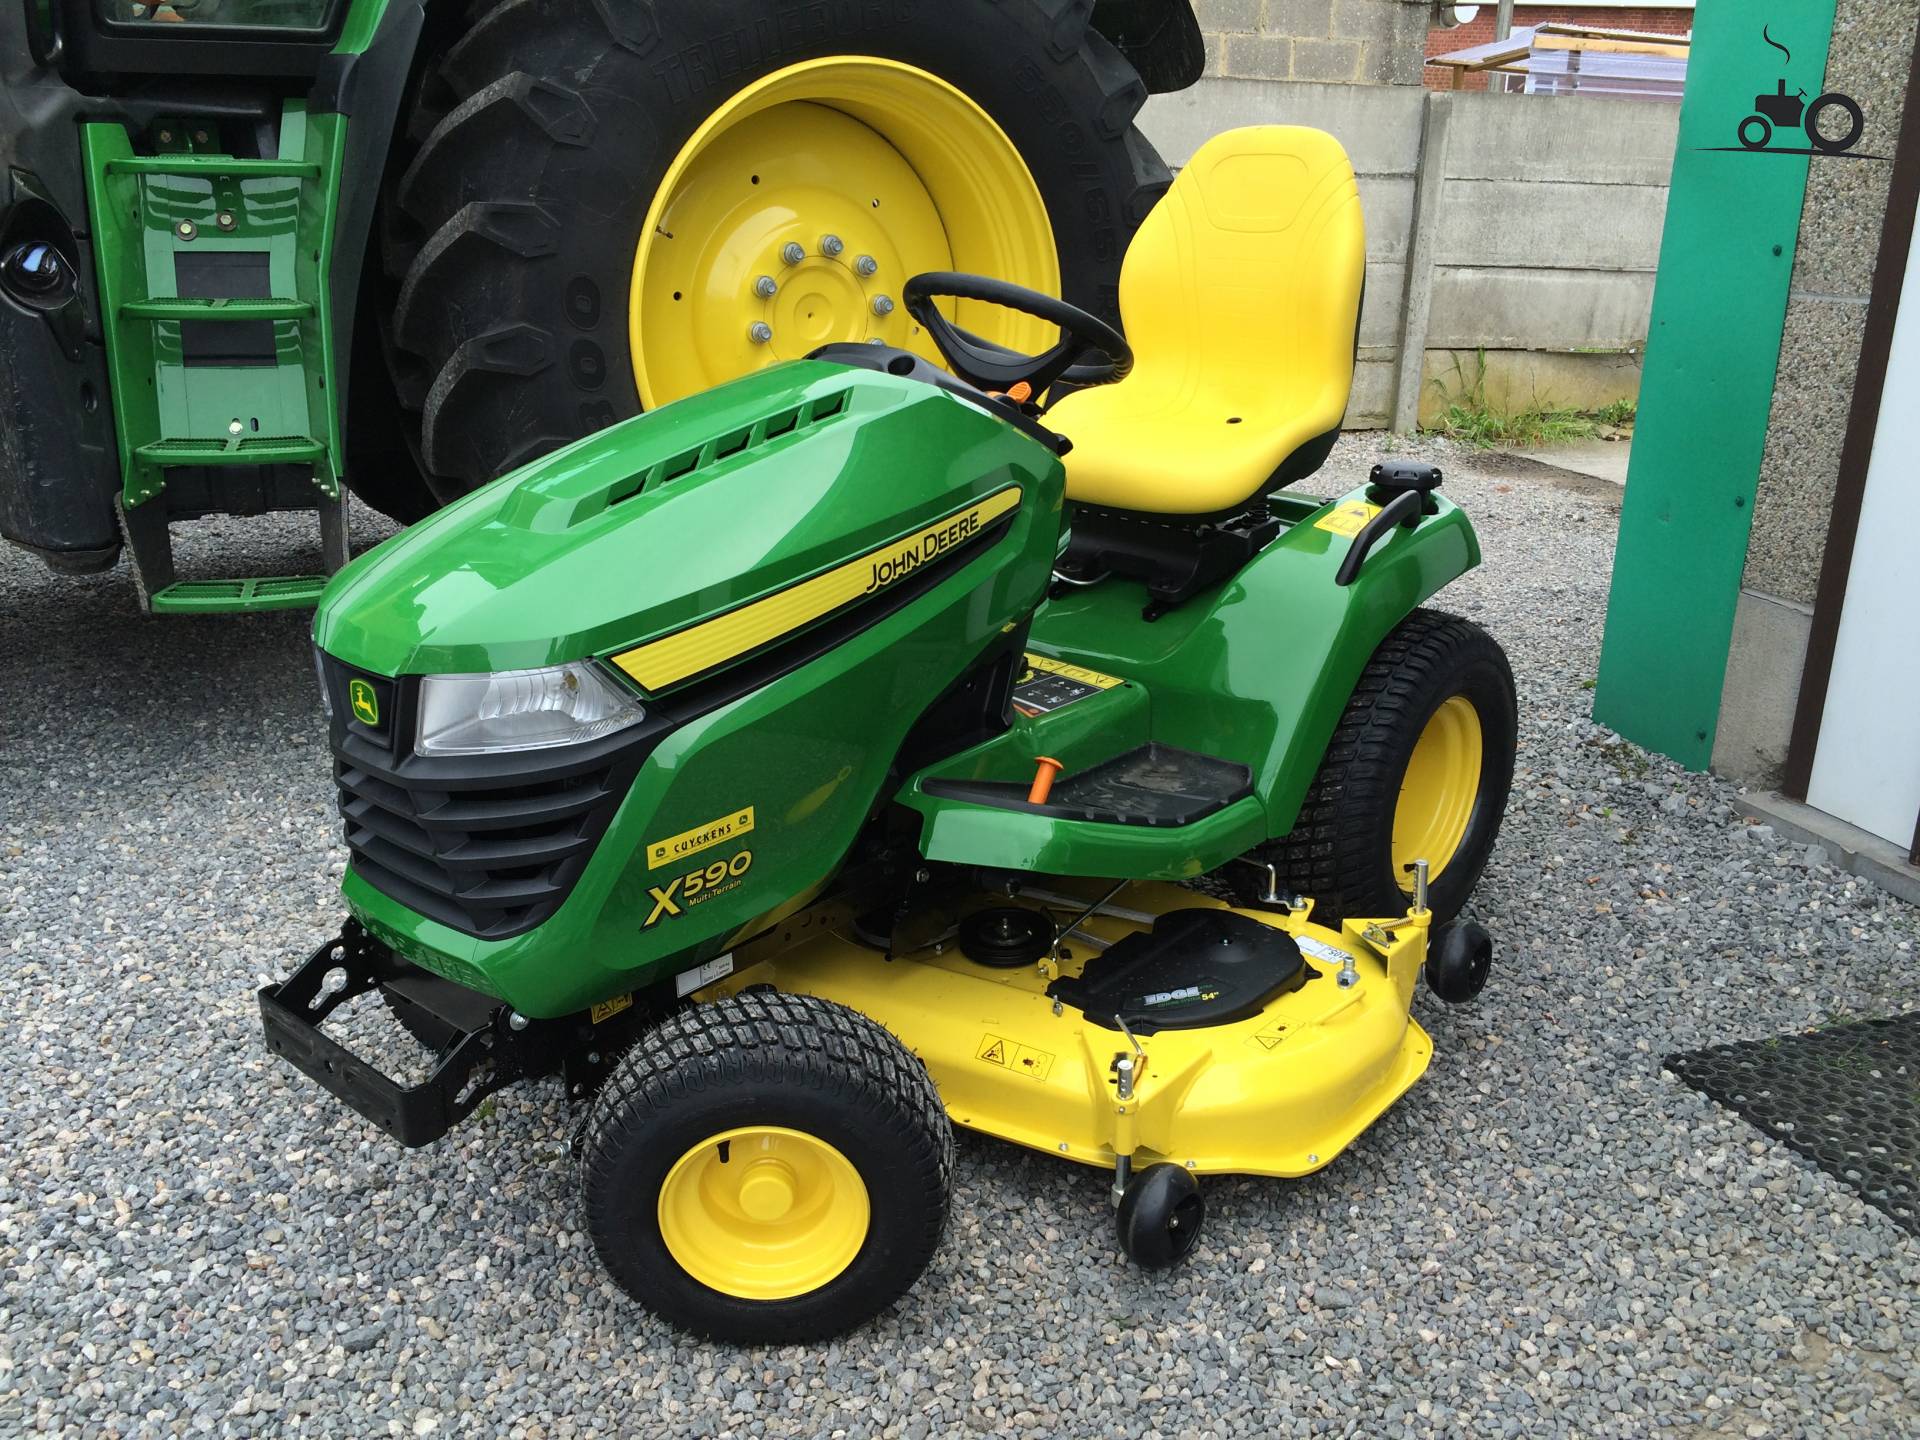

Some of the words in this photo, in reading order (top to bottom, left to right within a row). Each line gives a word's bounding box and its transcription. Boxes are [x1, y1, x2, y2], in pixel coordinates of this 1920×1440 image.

[866, 545, 920, 593] JOHN
[923, 511, 981, 560] DEERE
[673, 823, 732, 853] CUYCKENS
[642, 850, 752, 928] X590
